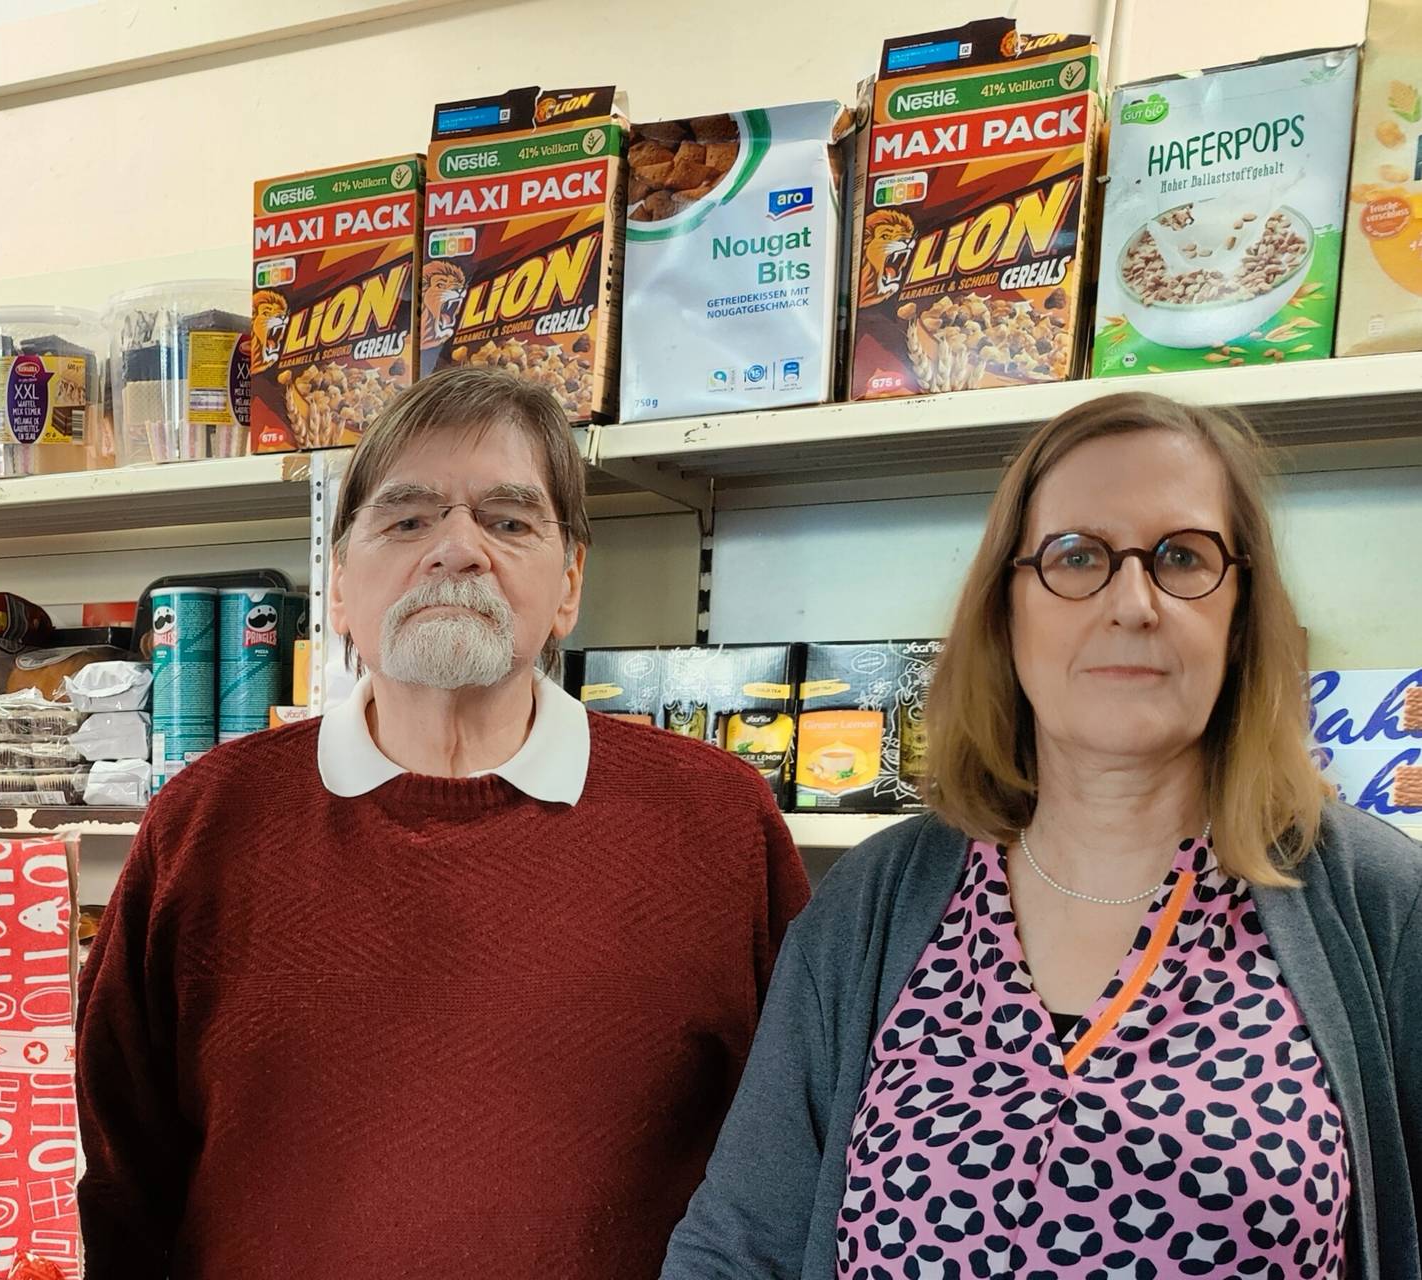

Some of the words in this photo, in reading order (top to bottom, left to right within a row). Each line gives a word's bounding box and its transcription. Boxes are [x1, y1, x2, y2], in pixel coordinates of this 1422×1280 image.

[980, 82, 1005, 97] 41%
[1007, 77, 1055, 94] Vollkorn
[554, 92, 596, 115] LION
[874, 123, 968, 163] MAXI
[982, 105, 1084, 147] PACK
[1148, 114, 1305, 177] HAFERPOPS
[518, 146, 538, 160] 41%
[540, 142, 579, 158] Vollkorn
[332, 180, 351, 193] 41%
[352, 177, 388, 190] Vollkorn
[1161, 179, 1188, 193] Hoher
[1190, 161, 1285, 188] Ballaststoffgehalt
[428, 184, 509, 218] MAXI
[520, 168, 604, 206] PACK
[776, 192, 804, 206] aro
[255, 216, 324, 251] MAXI
[335, 202, 411, 237] PACK
[907, 178, 1076, 286] LION
[712, 226, 812, 260] Nougat
[460, 234, 597, 331] LION
[758, 260, 811, 286] Bits
[898, 284, 945, 301] KARAMELL
[947, 281, 956, 292] &
[960, 271, 1000, 291] SCHOKO
[1000, 255, 1072, 290] CEREALS
[283, 263, 409, 356] LION
[706, 289, 787, 308] GETREIDEKISSEN
[790, 286, 810, 298] MIT
[706, 298, 809, 319] NOUGATGESCHMACK
[535, 304, 594, 335] CEREALS
[353, 330, 407, 360] CEREALS
[236, 363, 251, 380] XX
[14, 384, 40, 400] XXL
[244, 629, 278, 646] PRINGLES
